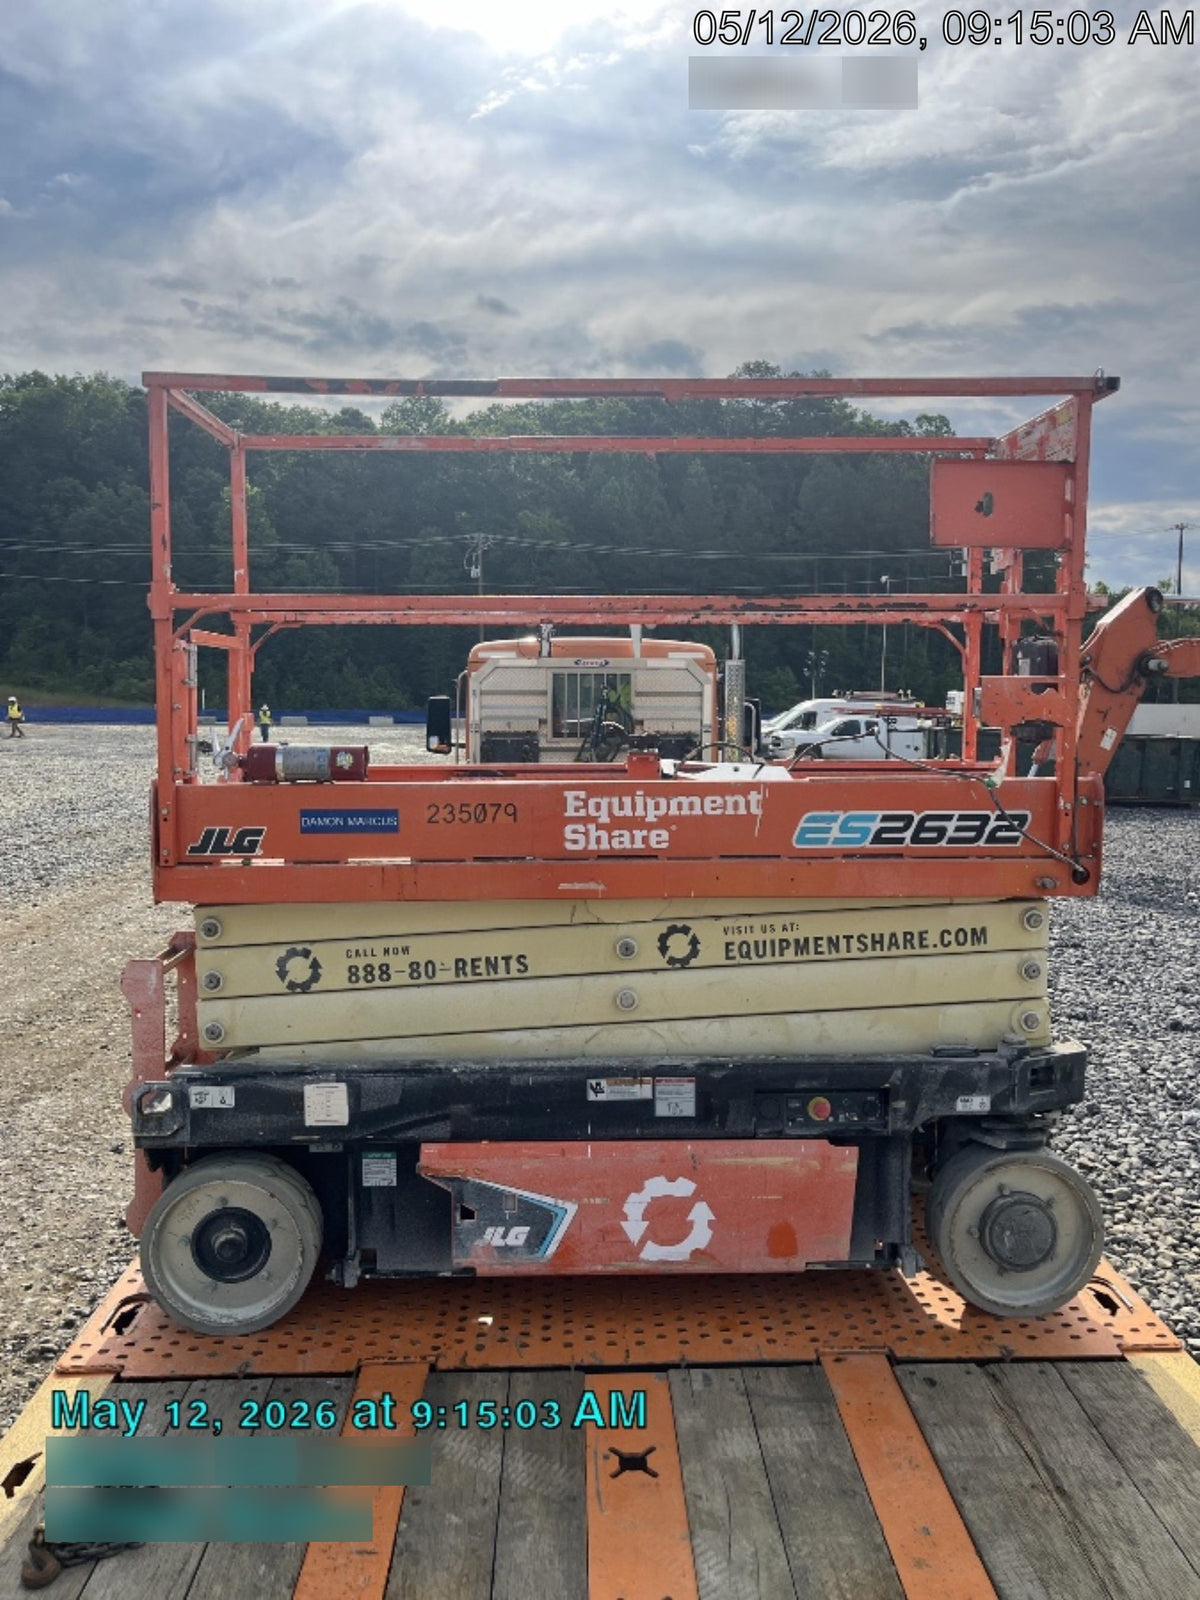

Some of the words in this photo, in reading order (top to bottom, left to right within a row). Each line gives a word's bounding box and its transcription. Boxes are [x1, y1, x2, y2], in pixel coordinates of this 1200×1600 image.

[426, 802, 518, 824] 235079
[563, 790, 763, 823] Equipment
[301, 816, 344, 828] DAMON
[793, 810, 1032, 848] ES2632
[186, 826, 267, 856] JLG
[563, 823, 670, 851] Share
[723, 924, 755, 937] VISIT
[760, 923, 776, 934] US
[781, 921, 801, 933] AT:
[724, 926, 989, 961] EQUIPMENTSHARE.COM
[345, 947, 378, 959] CALL
[383, 945, 412, 957] NOW
[347, 954, 530, 984] 888-80-RENTS
